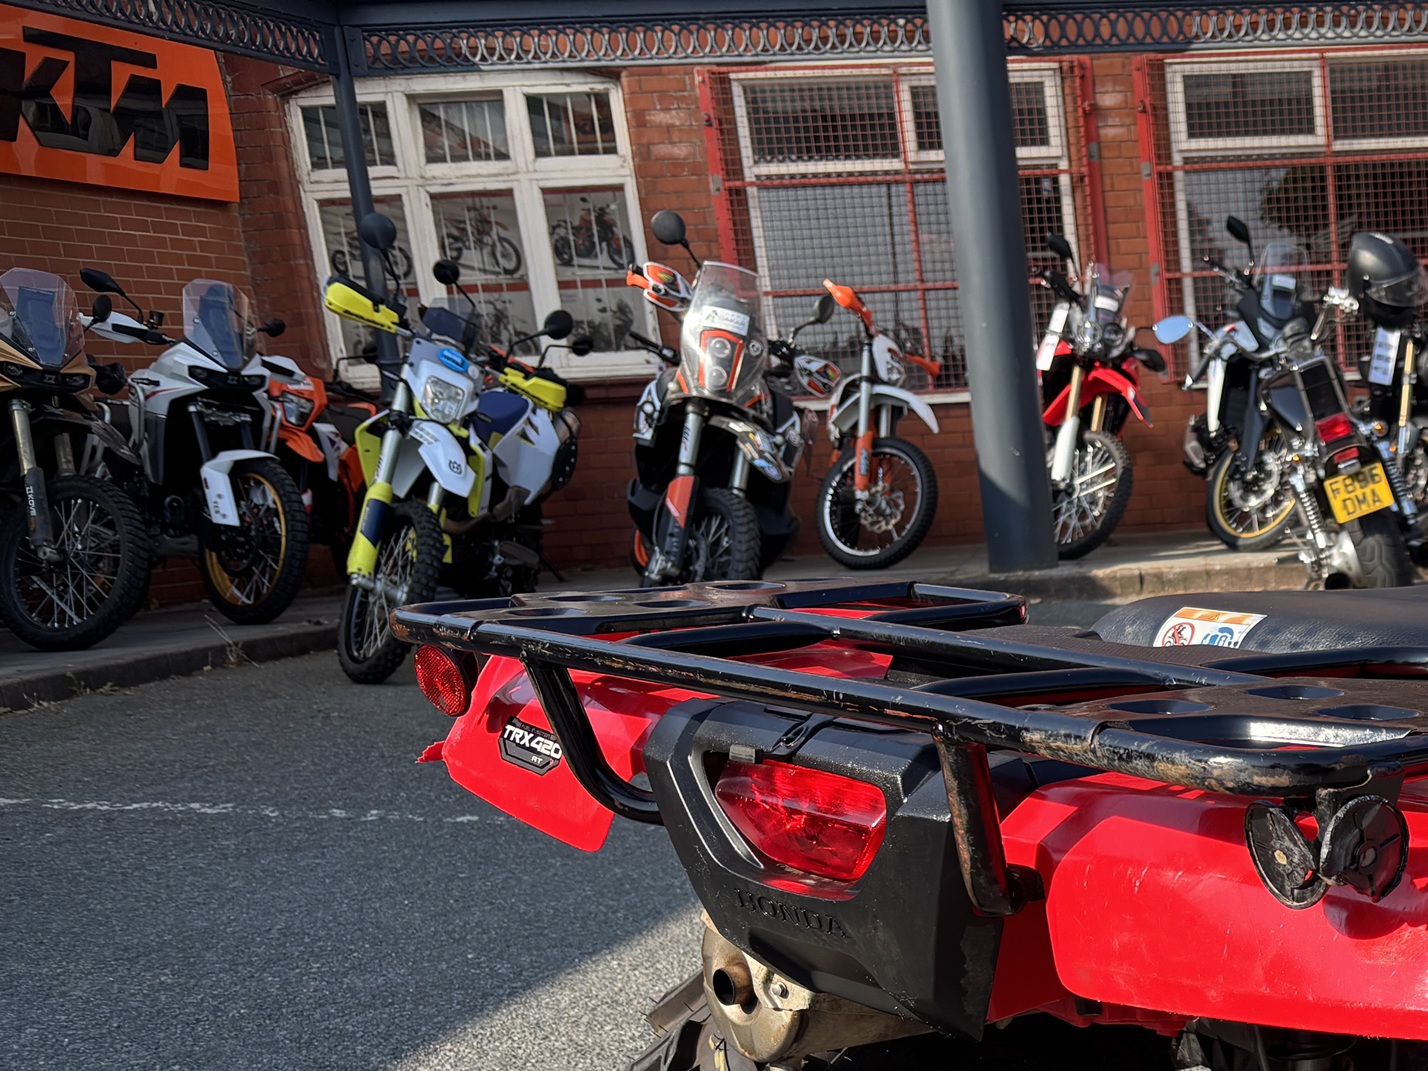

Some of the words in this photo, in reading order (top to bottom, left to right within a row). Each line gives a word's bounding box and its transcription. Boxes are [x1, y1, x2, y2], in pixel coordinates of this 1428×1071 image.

[0, 25, 210, 171] KTM
[1342, 488, 1383, 516] DMA
[503, 724, 563, 760] TRX420
[734, 887, 854, 939] HONDA
